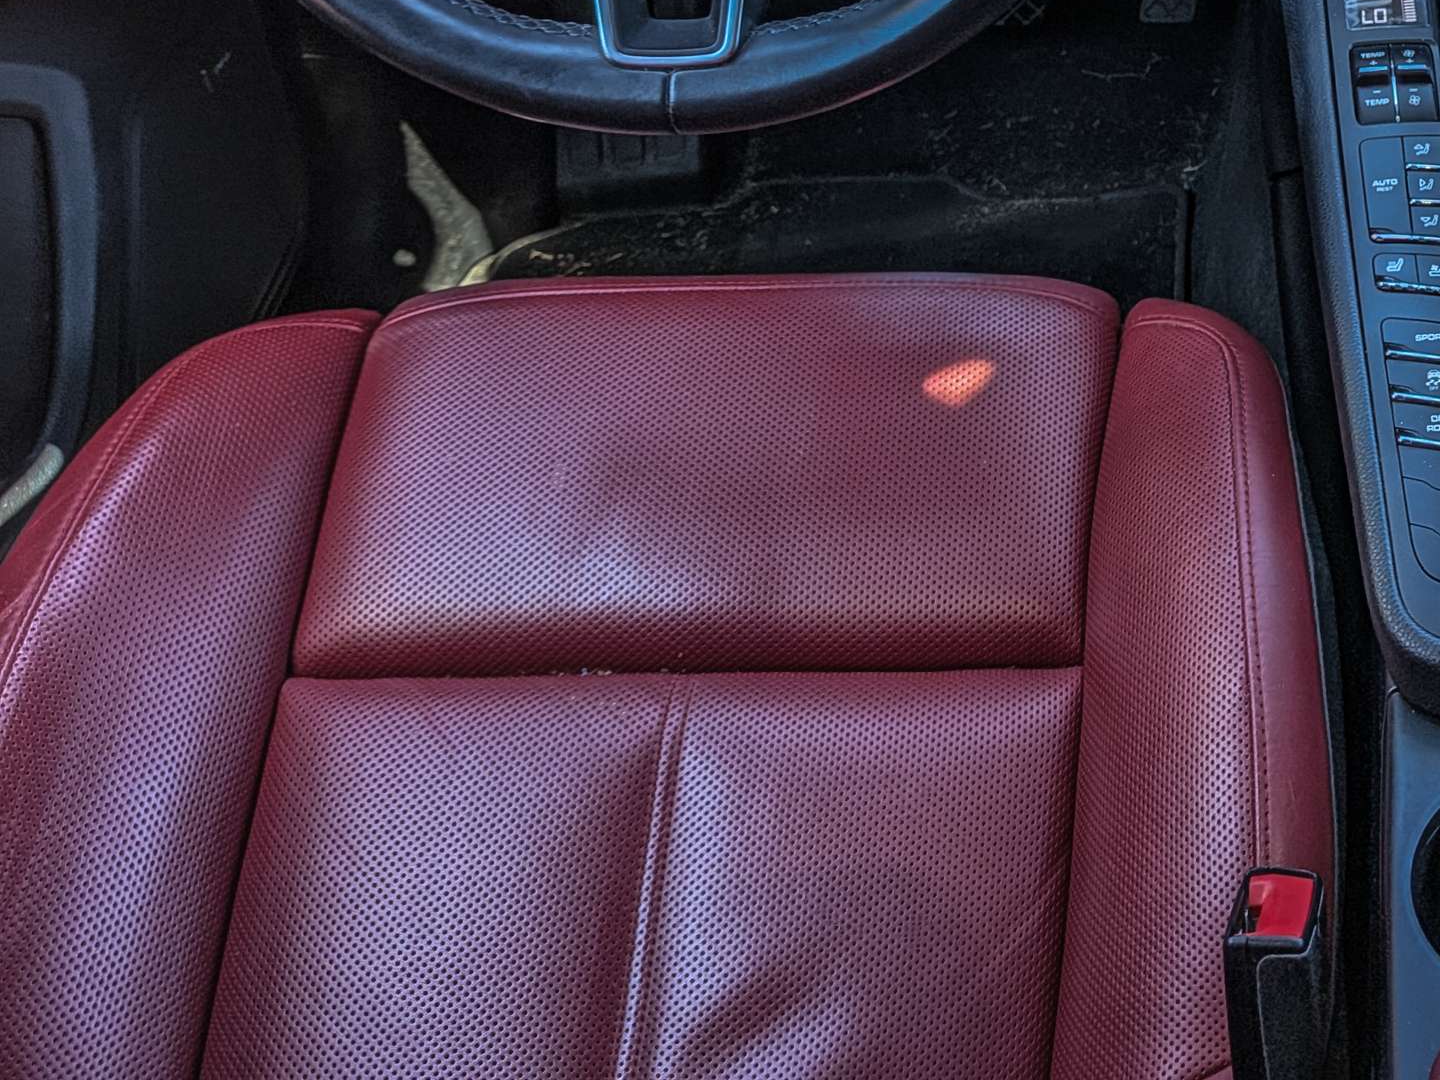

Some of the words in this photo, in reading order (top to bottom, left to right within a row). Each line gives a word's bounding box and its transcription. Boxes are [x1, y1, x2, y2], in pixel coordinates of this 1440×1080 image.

[1361, 8, 1388, 24] LO
[1360, 51, 1385, 59] TEMP
[1365, 98, 1390, 106] TEMP
[1372, 178, 1398, 186] AUTO
